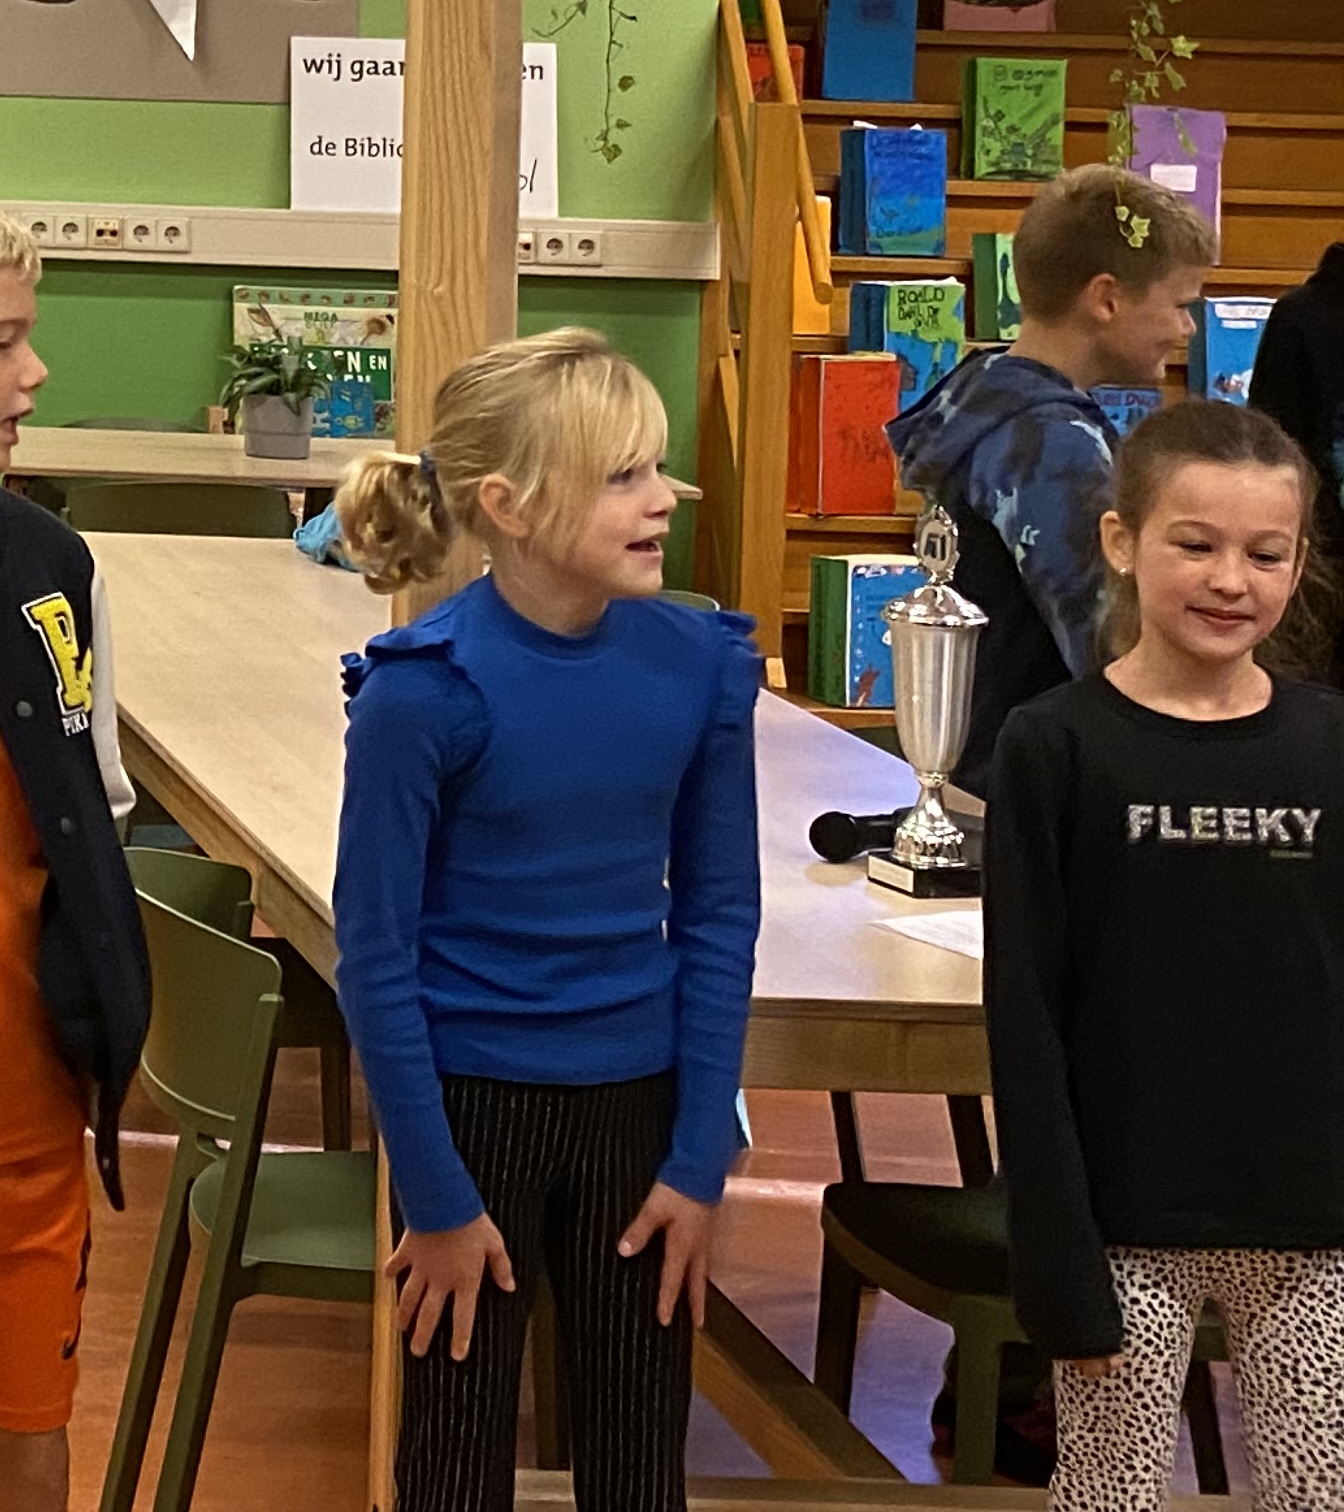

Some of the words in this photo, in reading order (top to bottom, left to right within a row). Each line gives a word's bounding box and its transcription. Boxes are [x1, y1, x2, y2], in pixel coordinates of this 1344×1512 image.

[302, 53, 342, 81] wij
[309, 135, 337, 156] de
[369, 354, 388, 370] EN
[1126, 803, 1323, 845] FLEEKY
